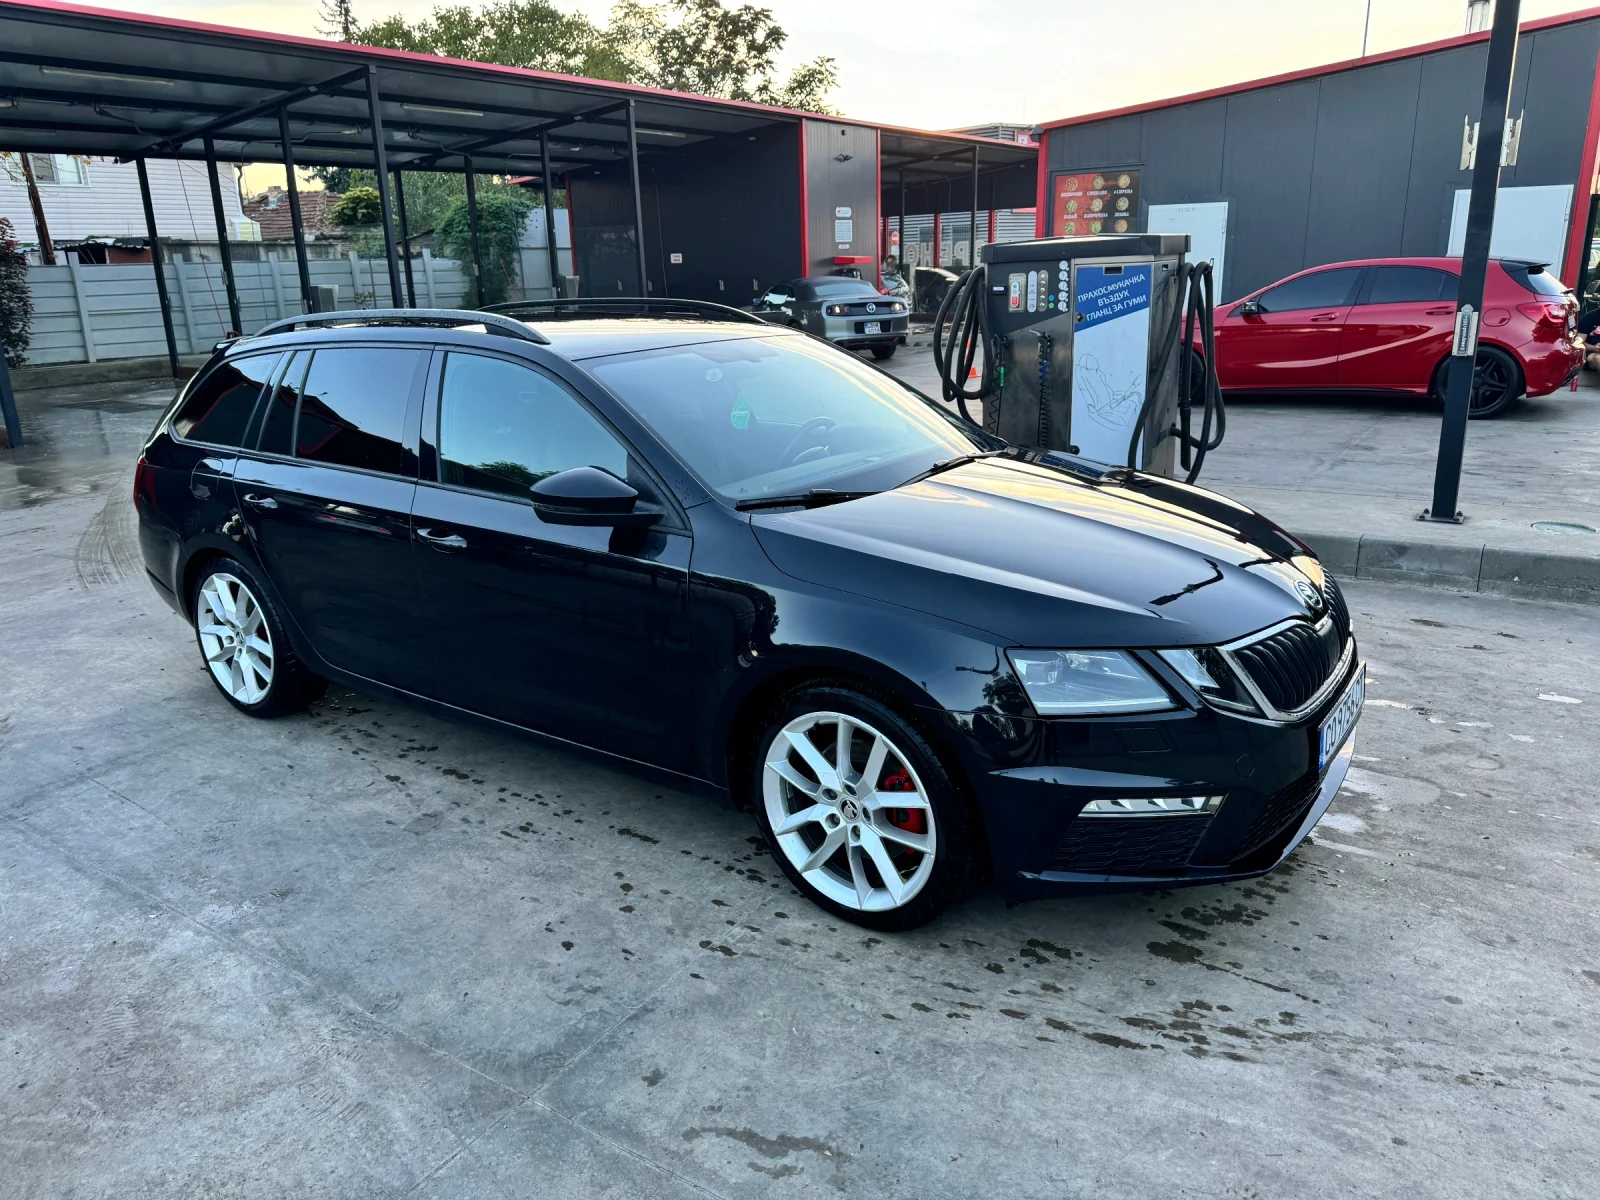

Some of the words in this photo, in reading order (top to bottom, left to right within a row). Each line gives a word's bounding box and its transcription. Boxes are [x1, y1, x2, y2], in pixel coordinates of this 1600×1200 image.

[1077, 273, 1146, 303] ПРАХОСМУКАЧКА
[1097, 289, 1130, 307] ВЪЗДУХ
[1086, 306, 1113, 322] ГЛАНЦ
[1111, 303, 1124, 313] ЗА
[1123, 294, 1147, 309] ГУМИ
[1325, 716, 1337, 756] CO
